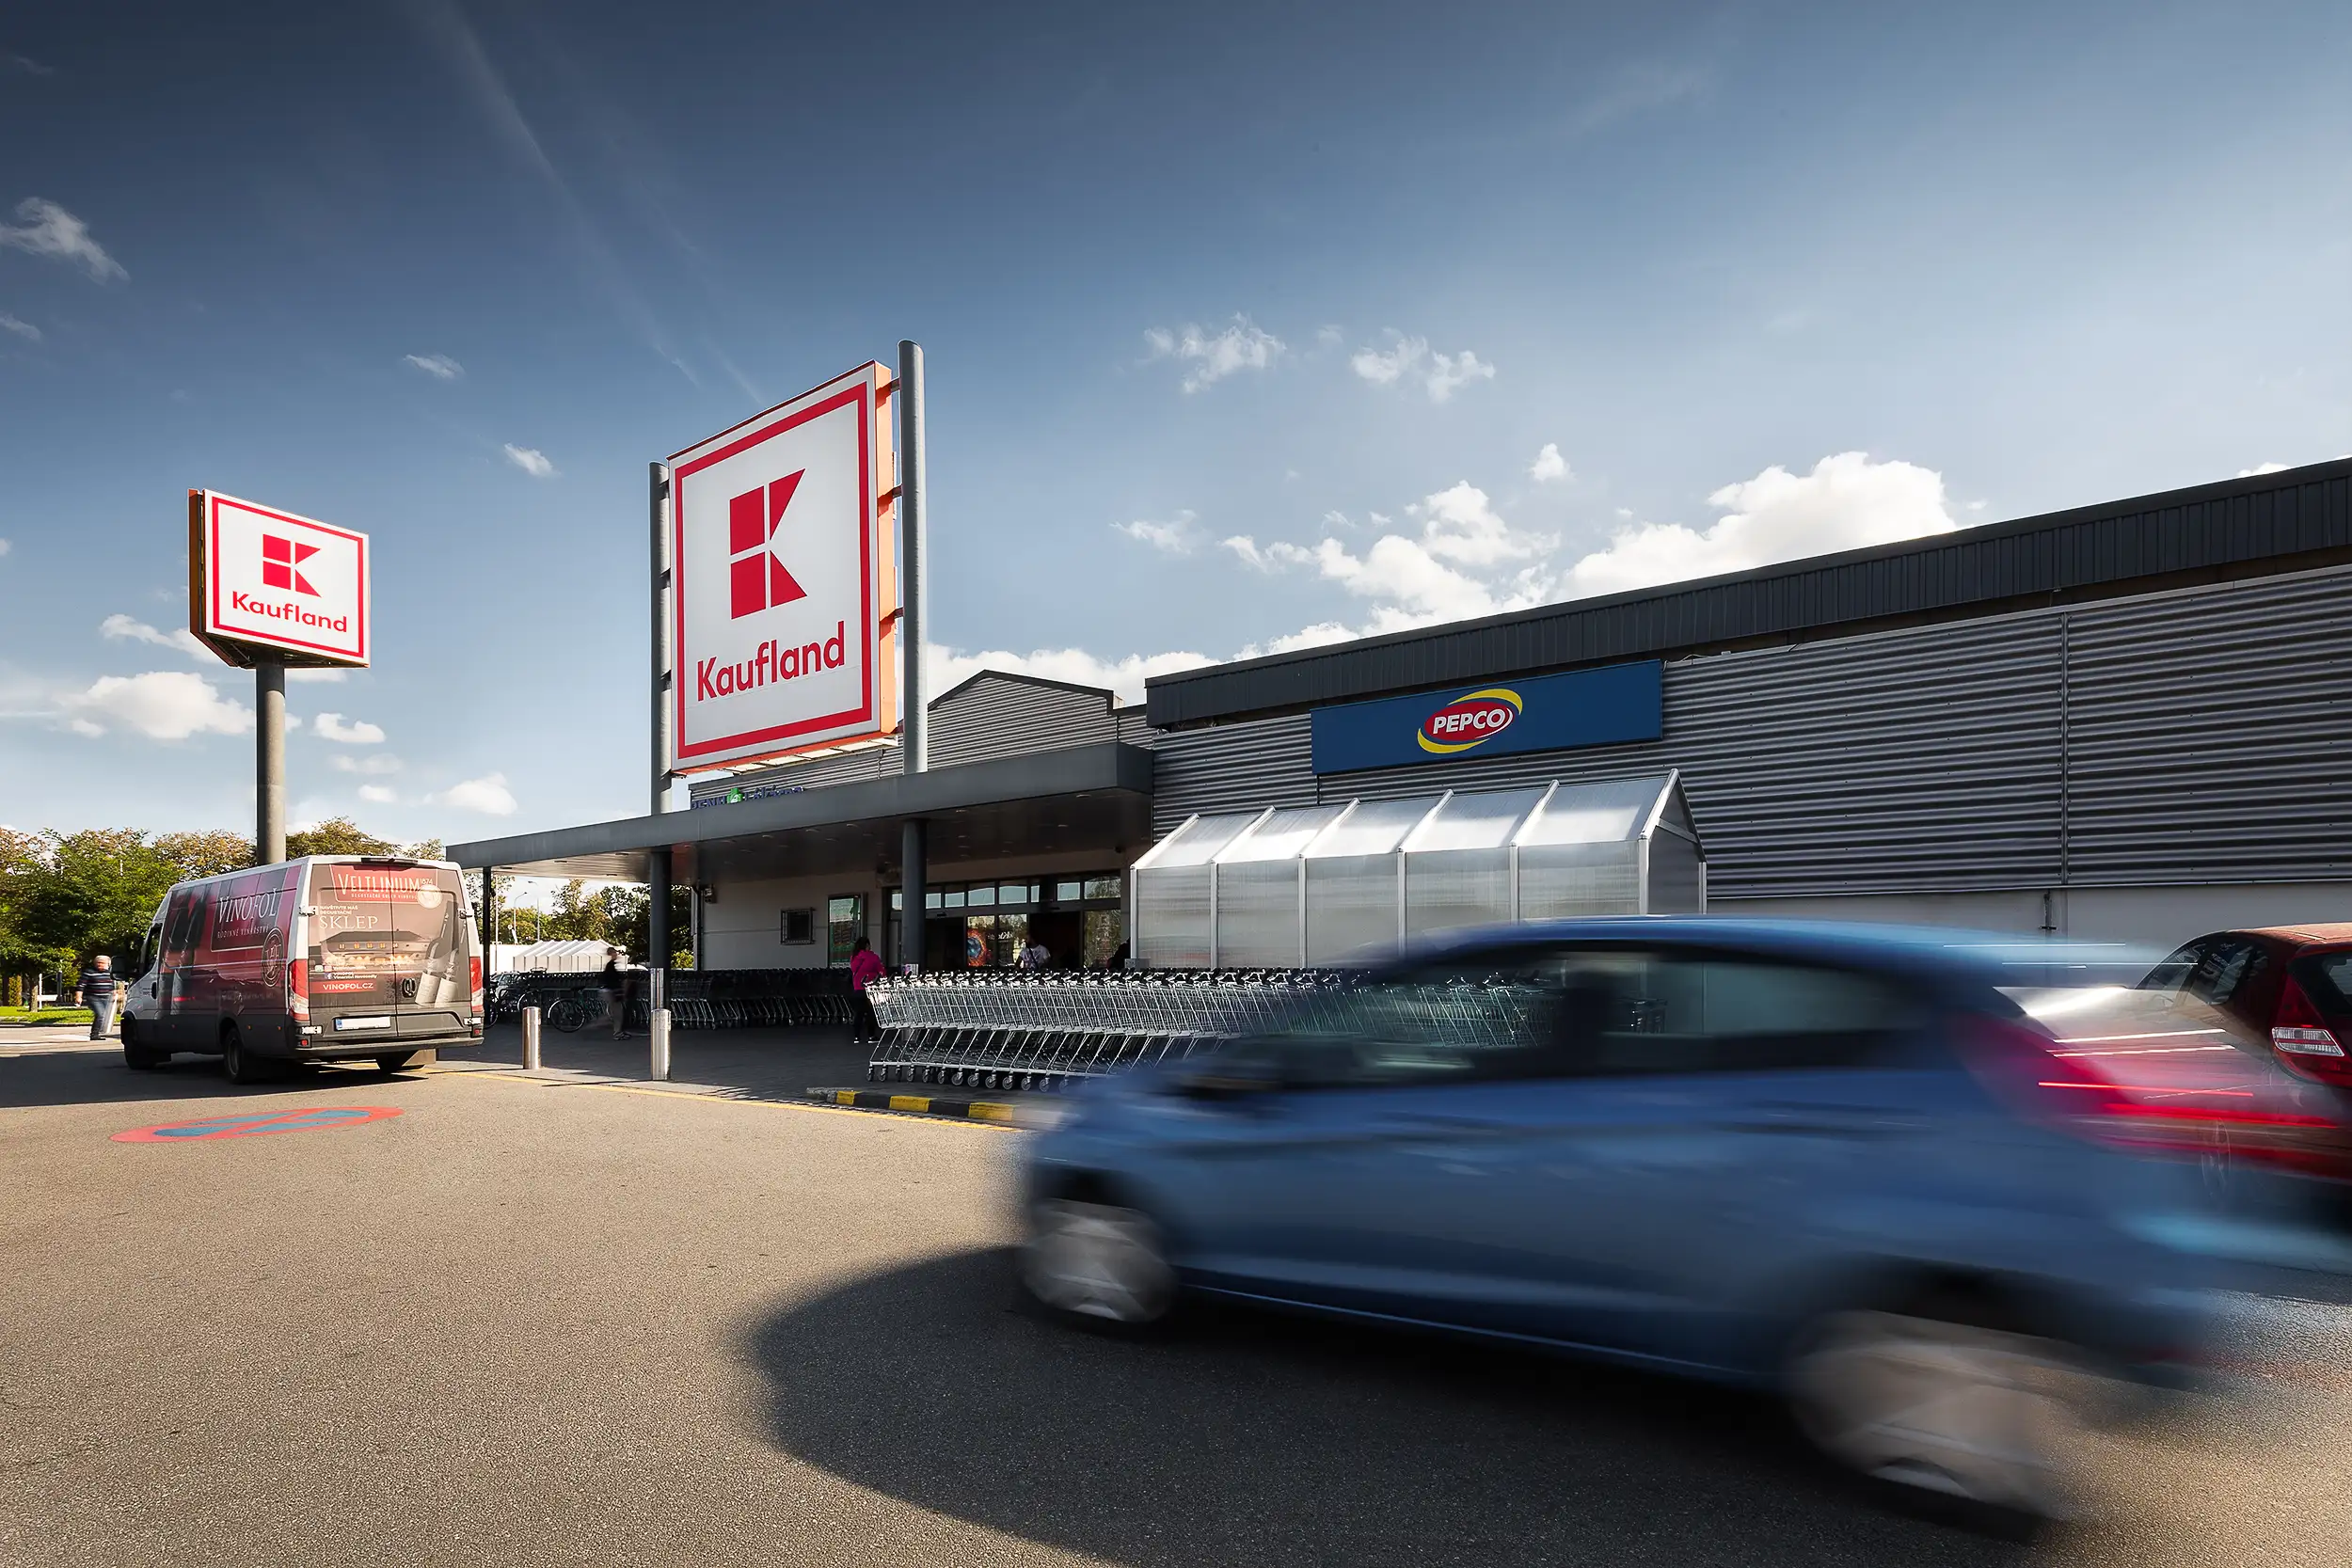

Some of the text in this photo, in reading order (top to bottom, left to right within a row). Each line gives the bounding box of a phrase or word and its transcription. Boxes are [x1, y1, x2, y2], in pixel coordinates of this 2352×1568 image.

[232, 591, 347, 633] Kaufland
[697, 620, 845, 702] Kaufland
[1433, 708, 1506, 735] PEPCO
[338, 873, 421, 895] VELTLINIUM
[218, 887, 278, 924] VINOFOL
[320, 915, 378, 929] SKLEP
[323, 982, 374, 990] VINOFOL.CZ
